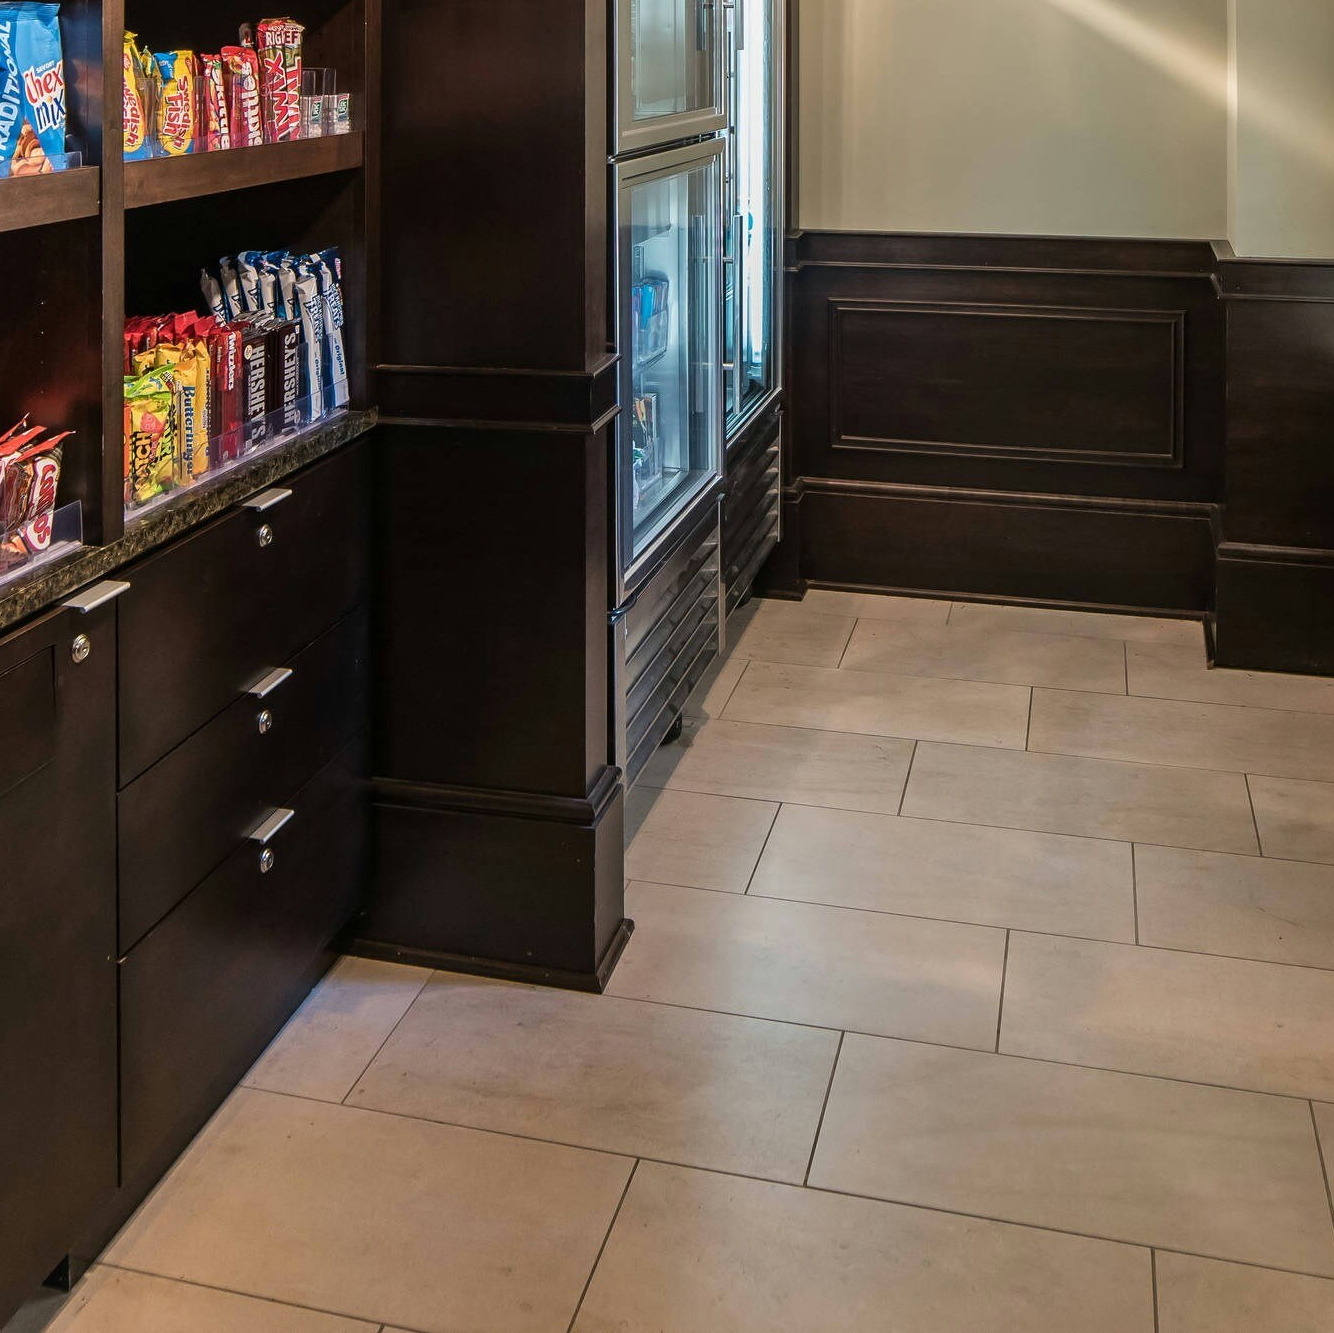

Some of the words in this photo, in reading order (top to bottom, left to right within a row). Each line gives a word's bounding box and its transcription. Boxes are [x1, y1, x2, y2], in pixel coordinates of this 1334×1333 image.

[25, 64, 64, 104] Chex
[36, 89, 66, 131] mix
[164, 93, 183, 136] Fish
[174, 75, 191, 149] Swedish
[241, 61, 263, 148] Skittles
[265, 51, 289, 138] TWIX
[124, 93, 141, 147] wedish
[324, 290, 340, 329] TREATS
[228, 332, 236, 390] Twizzlers
[250, 345, 266, 439] HERSHEY'S
[283, 332, 296, 425] HERSHEY'S
[333, 345, 346, 375] Original
[182, 385, 196, 477] Butterfinger
[33, 465, 57, 544] Comos
